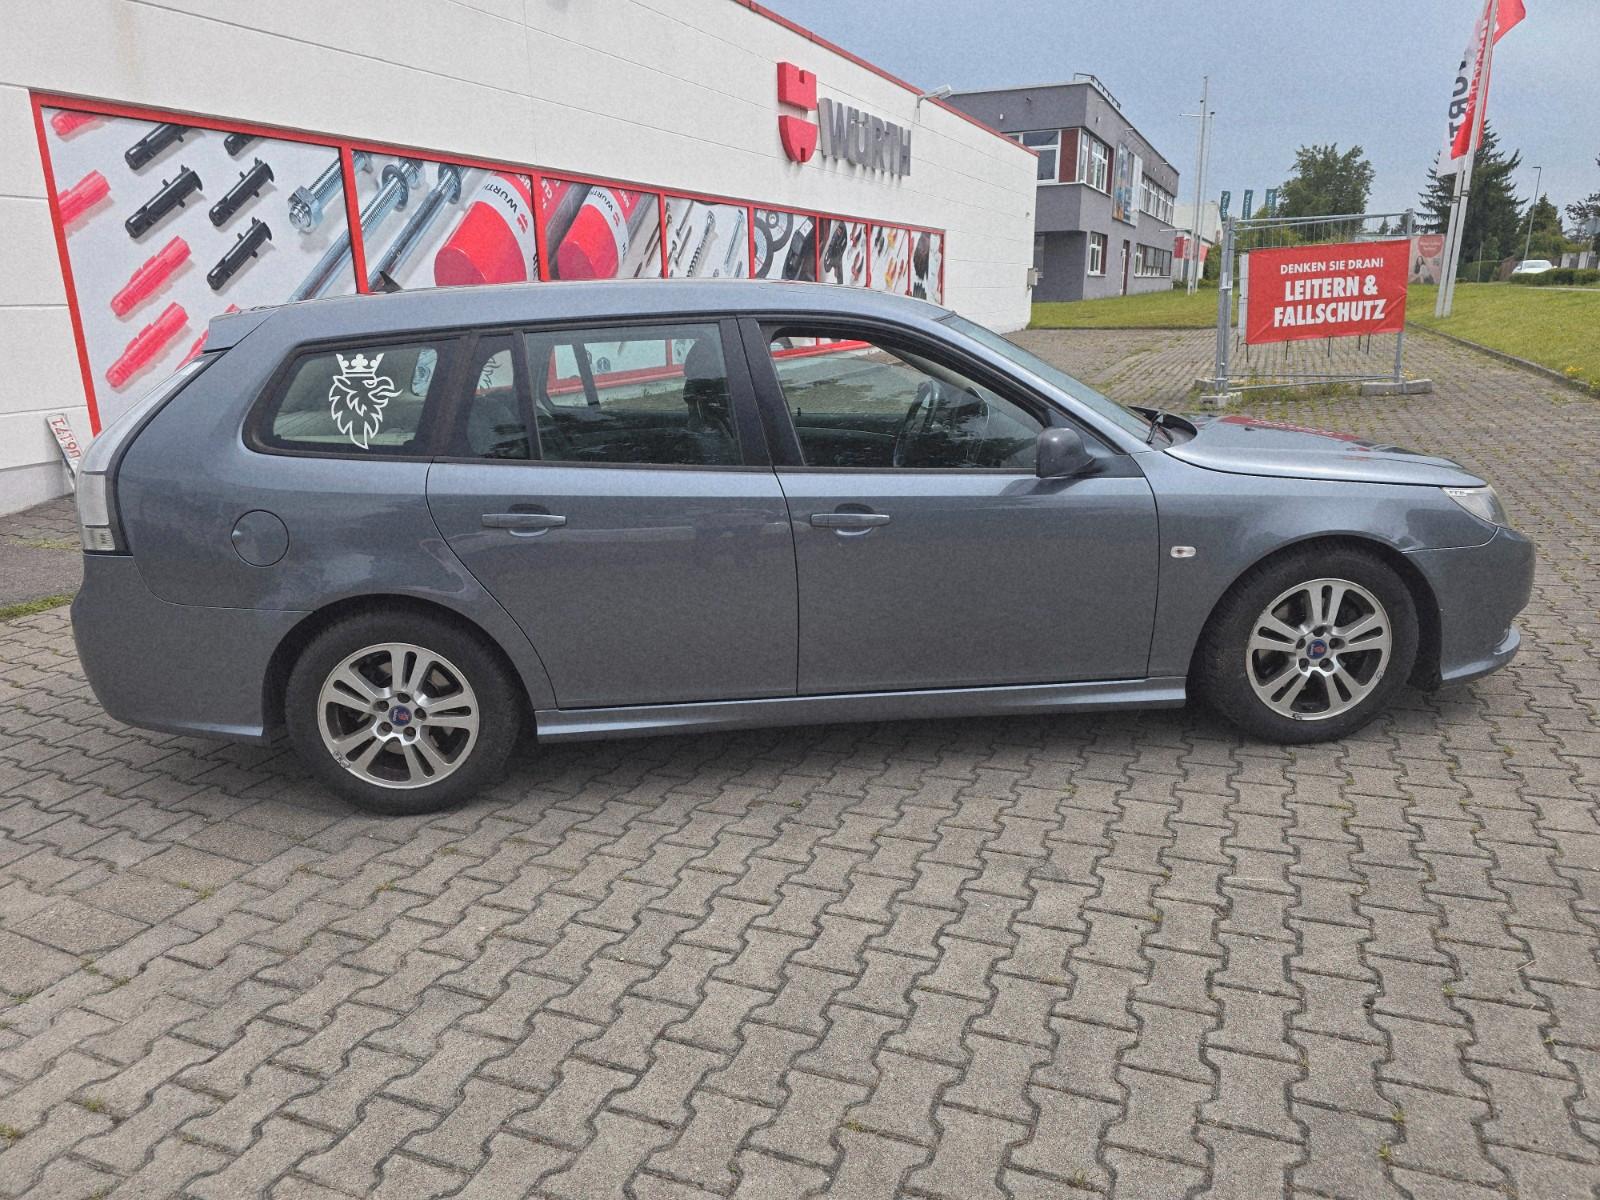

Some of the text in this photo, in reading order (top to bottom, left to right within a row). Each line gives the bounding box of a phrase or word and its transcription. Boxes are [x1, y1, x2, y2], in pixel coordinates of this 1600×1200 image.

[817, 97, 911, 177] WÜRTH
[1280, 258, 1384, 275] DENKEN SIE DRAN!
[1284, 274, 1378, 302] LEITERN &
[1274, 299, 1387, 327] FALLSCHUTZ
